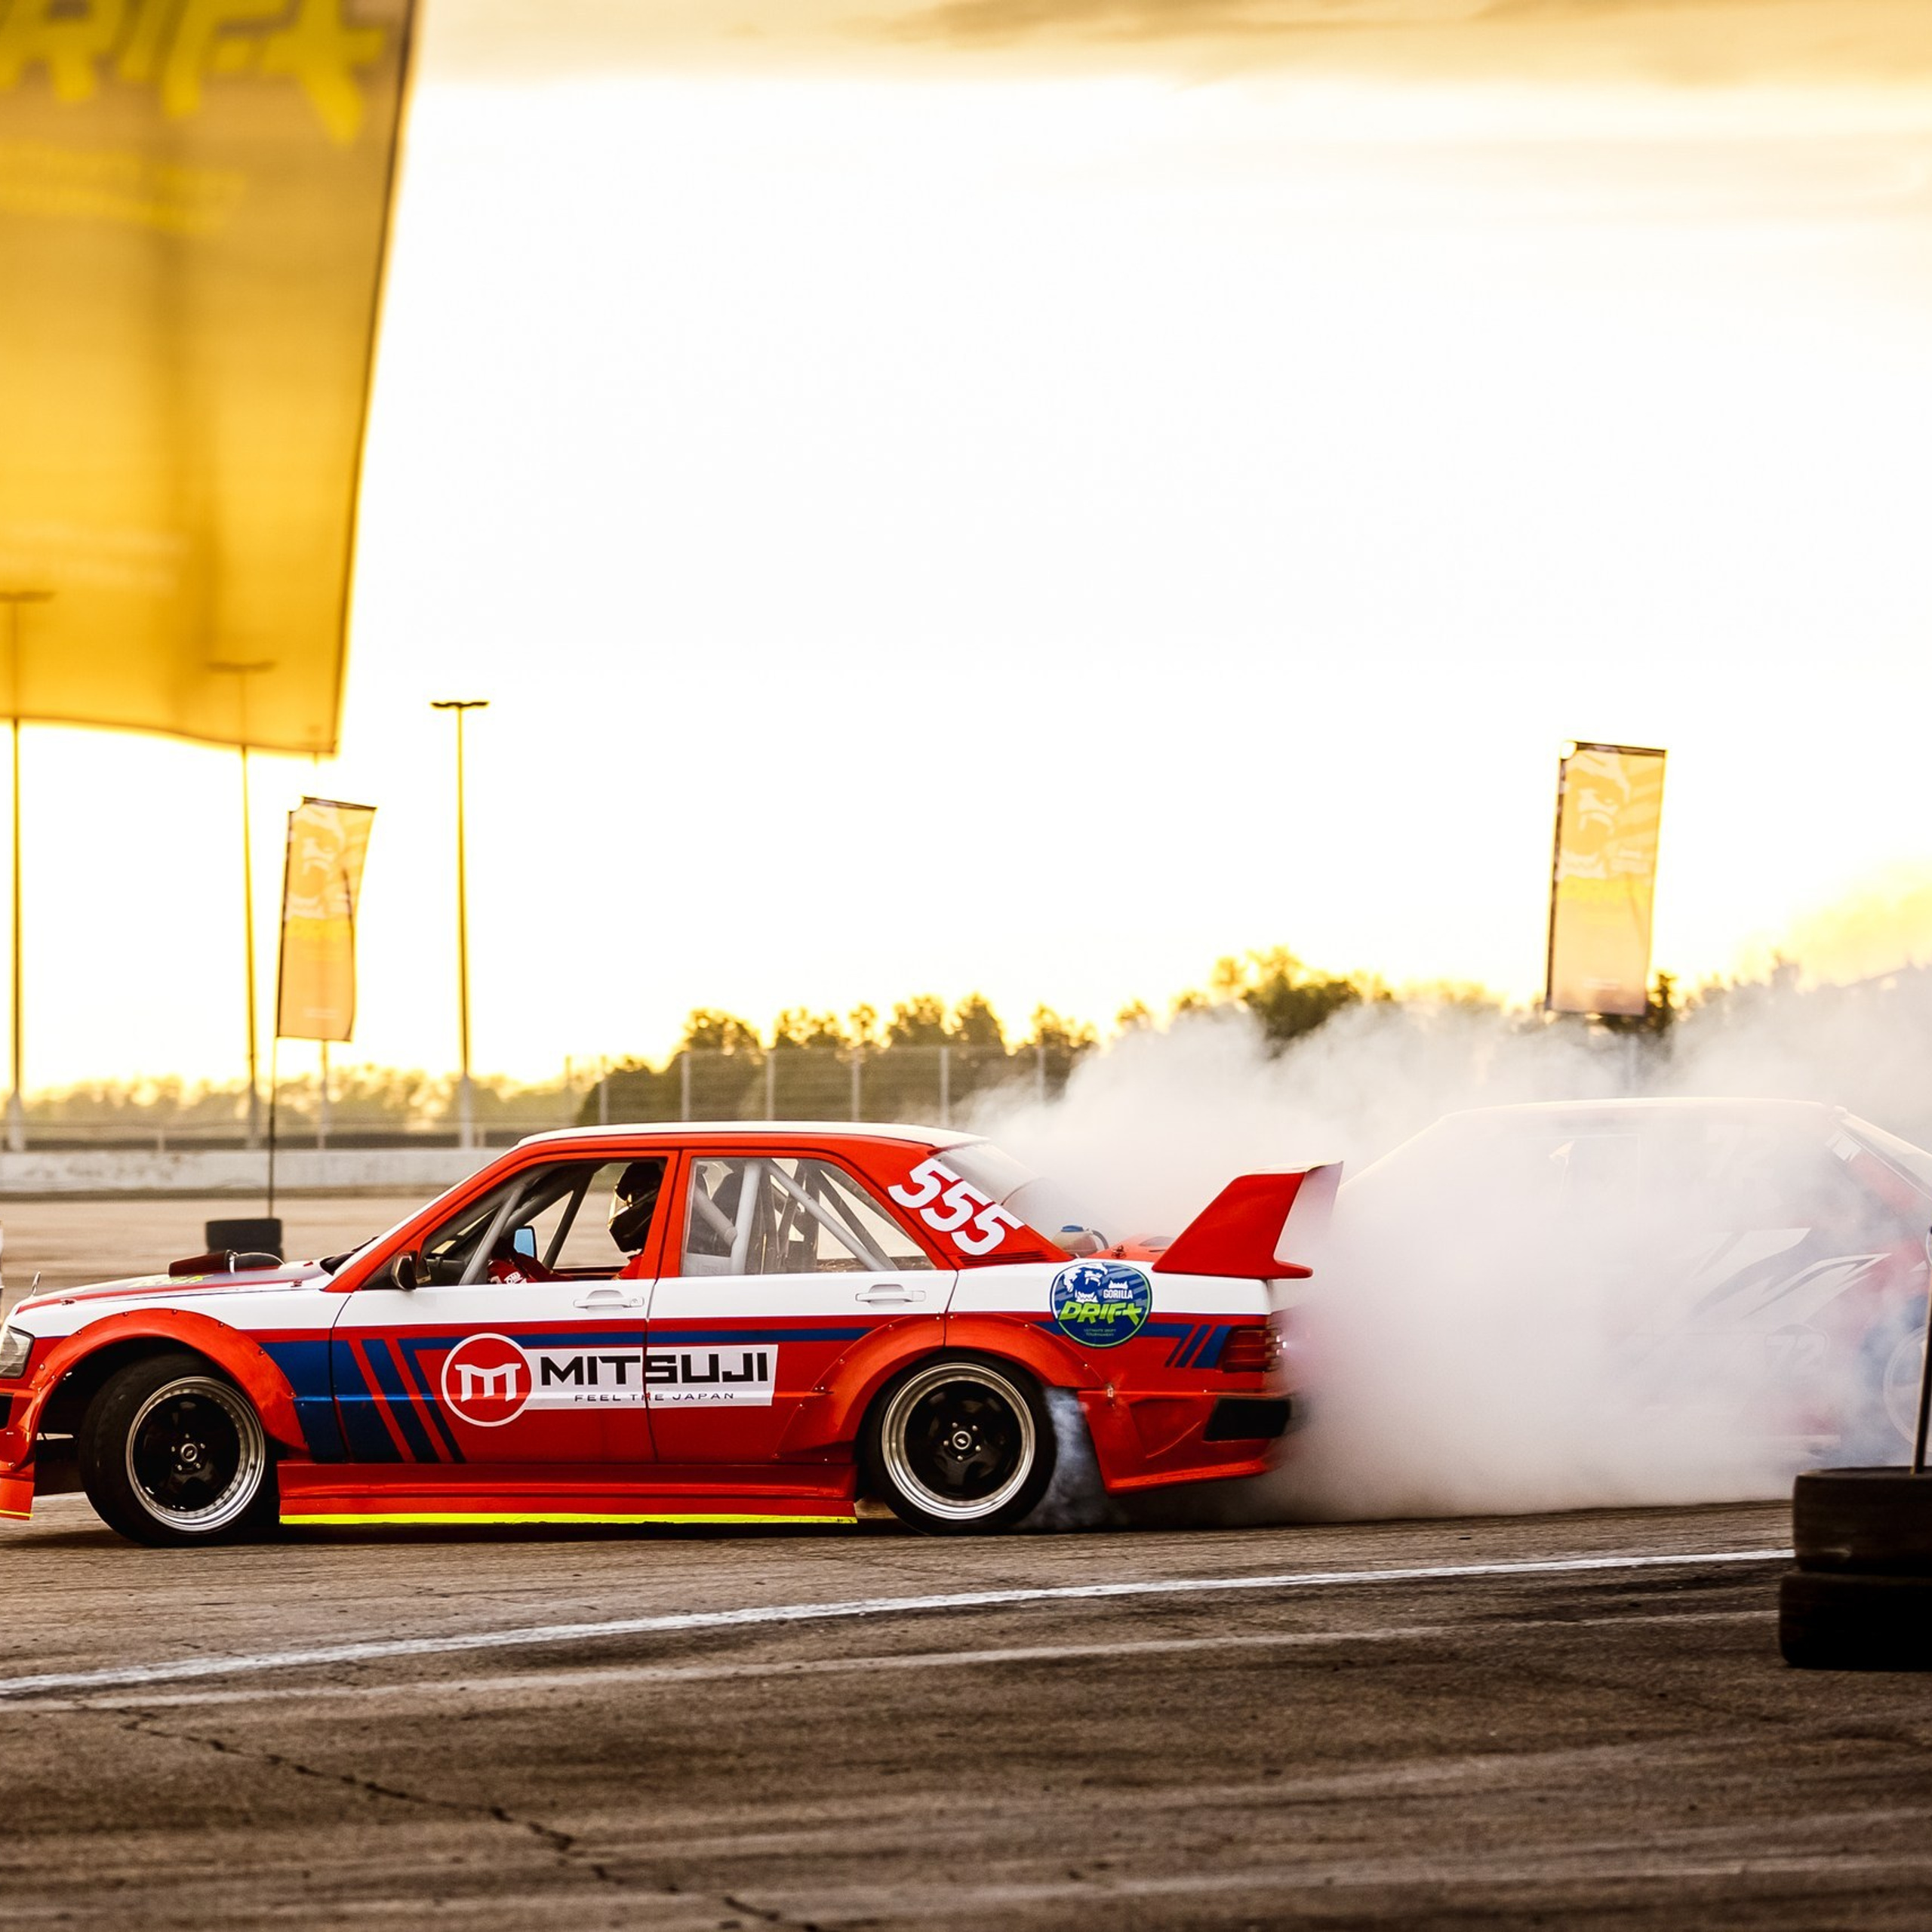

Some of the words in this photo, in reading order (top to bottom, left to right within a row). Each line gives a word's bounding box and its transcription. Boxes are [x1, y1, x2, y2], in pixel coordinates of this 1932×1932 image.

[888, 1158, 1026, 1256] 555
[1103, 1289, 1134, 1299] GORILLA
[1059, 1301, 1142, 1326] DRIFT
[540, 1352, 768, 1386] MITSUJI
